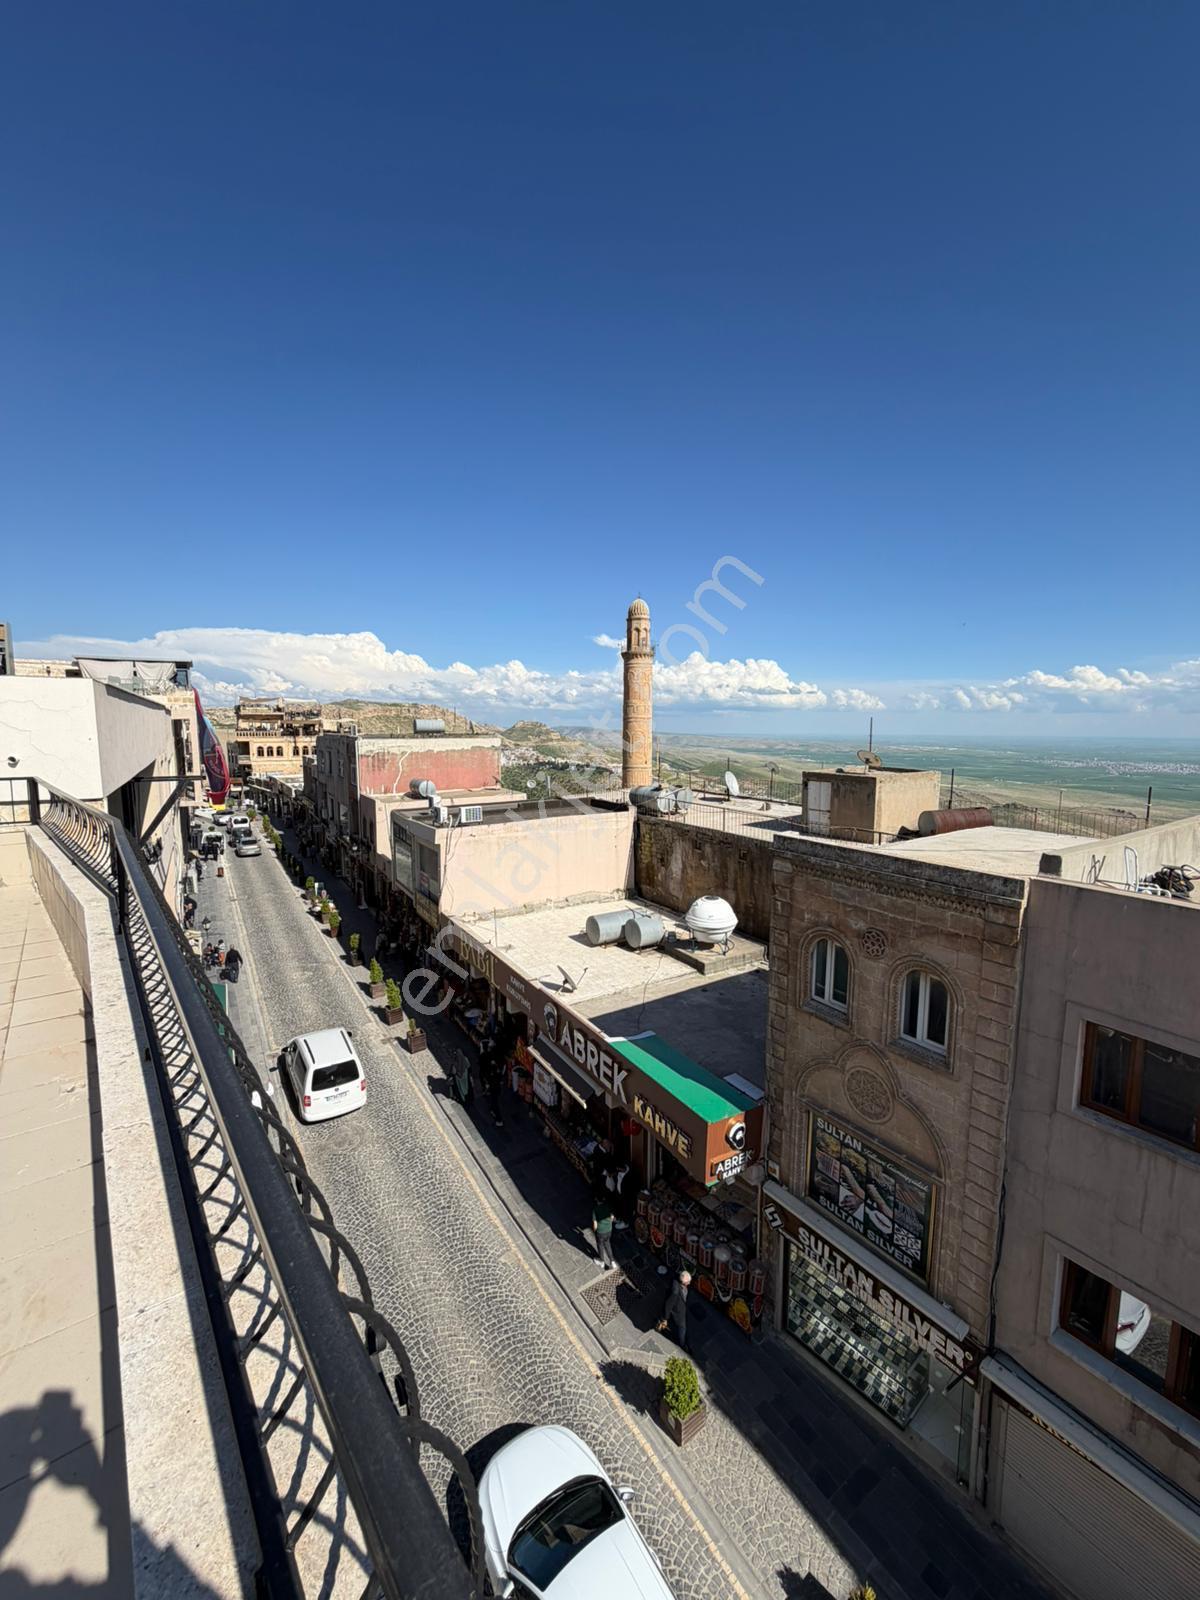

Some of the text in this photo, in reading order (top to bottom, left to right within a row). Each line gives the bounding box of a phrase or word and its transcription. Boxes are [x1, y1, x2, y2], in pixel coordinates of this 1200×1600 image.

[560, 1021, 628, 1105] ABREK
[633, 1094, 691, 1159] KAHVE
[716, 1149, 753, 1175] ABREK
[816, 1117, 862, 1151] SULTAN
[818, 1194, 913, 1269] SULTAN SILVER
[797, 1226, 874, 1297] SULTAN
[878, 1288, 965, 1369] SILVER
